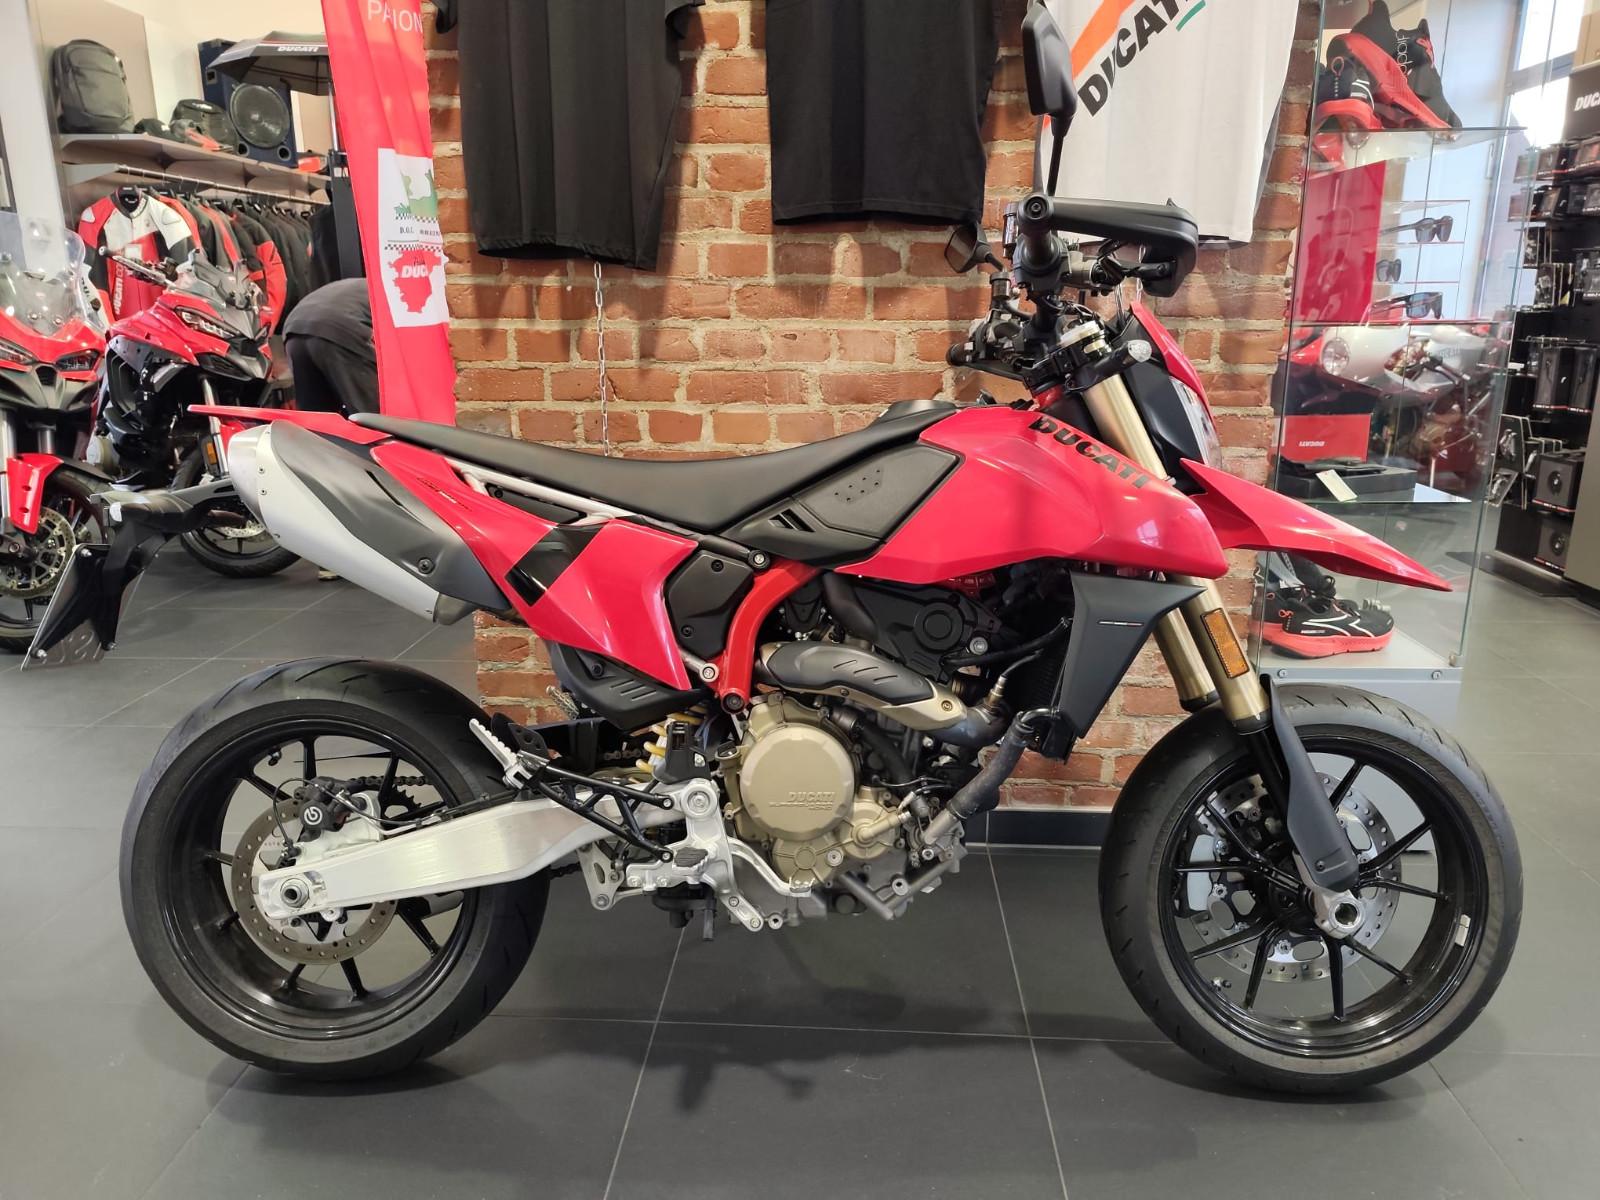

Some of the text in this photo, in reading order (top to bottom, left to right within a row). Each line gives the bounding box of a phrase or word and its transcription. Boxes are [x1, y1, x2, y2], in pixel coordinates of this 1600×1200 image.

[1077, 0, 1189, 117] DUCAT
[1574, 91, 1600, 112] DUC
[1028, 416, 1150, 489] DUCATI
[786, 791, 836, 802] DUCATI
